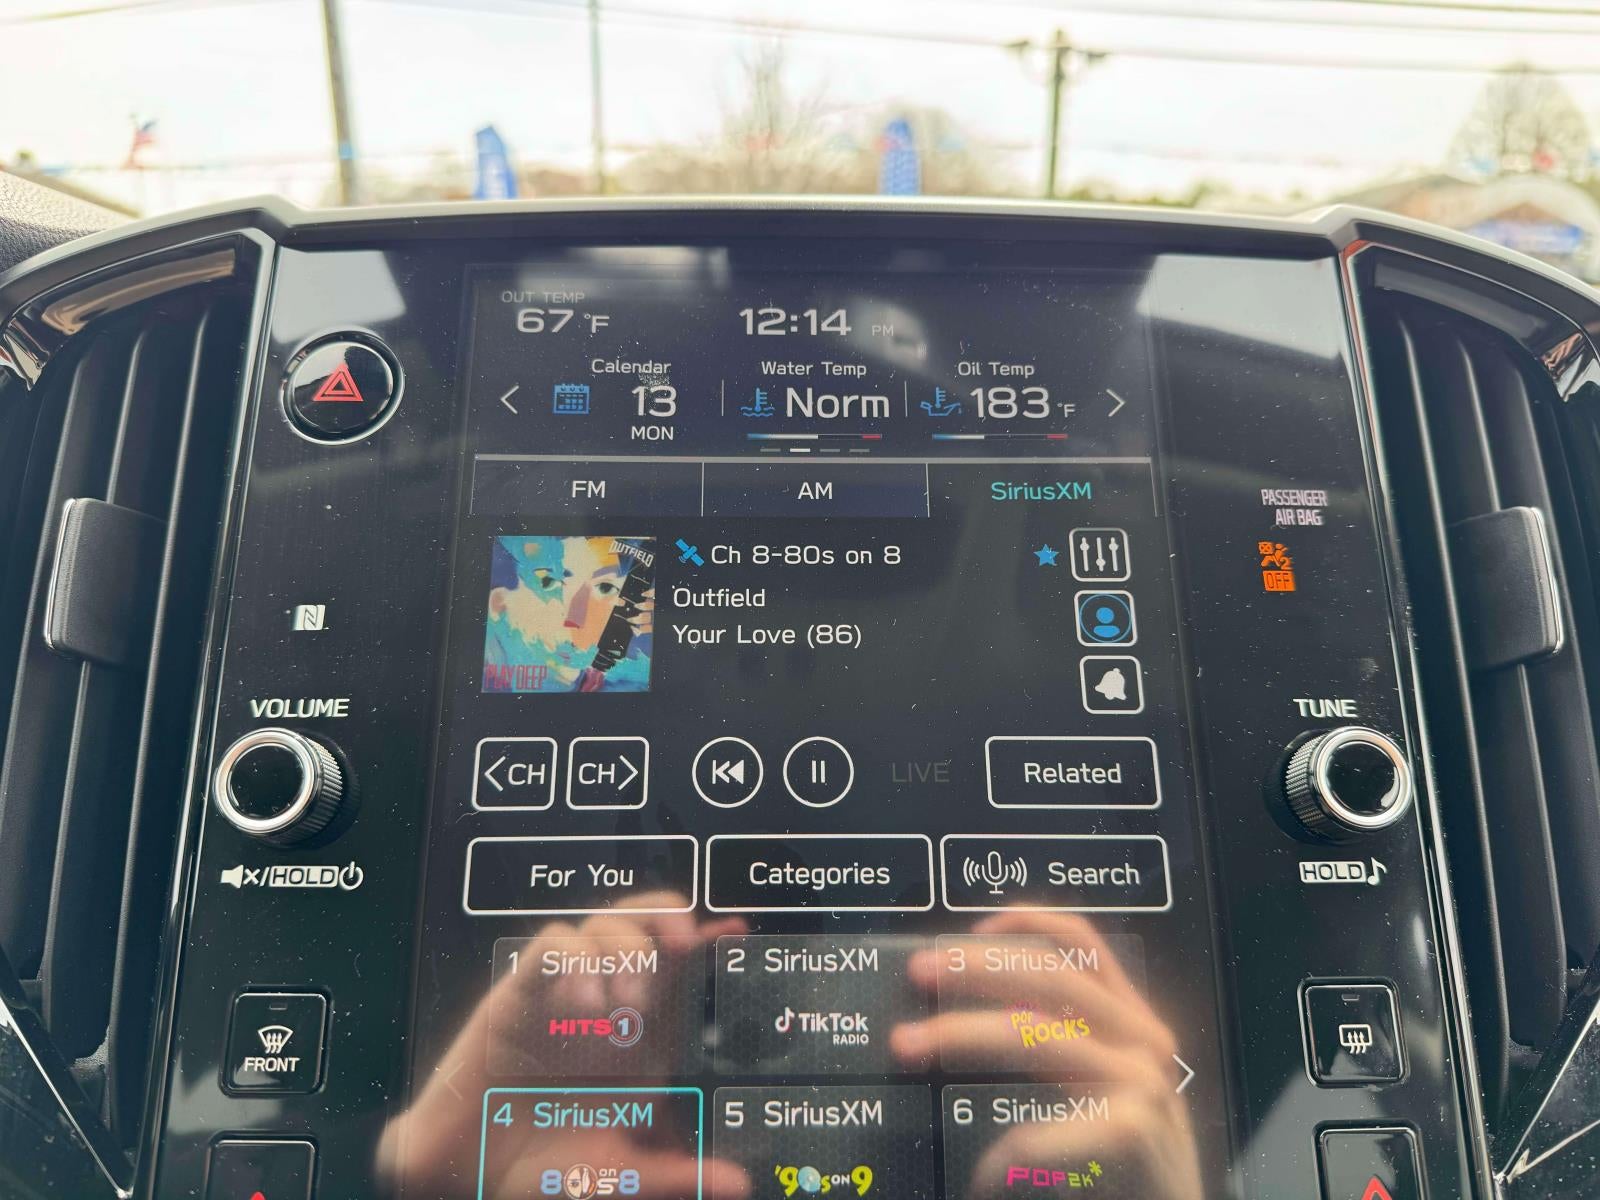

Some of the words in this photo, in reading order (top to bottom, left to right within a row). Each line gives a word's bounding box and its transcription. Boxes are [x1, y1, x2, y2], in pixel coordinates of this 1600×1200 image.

[501, 291, 533, 303] OUT
[543, 291, 585, 303] TEMP
[516, 309, 574, 333] 67
[739, 308, 852, 336] 12:14
[872, 325, 894, 337] PM
[591, 359, 671, 374] Calendar
[761, 361, 813, 376] Water
[822, 362, 867, 379] Temp
[958, 361, 981, 376] Oil
[989, 362, 1035, 379] Temp
[631, 385, 677, 417] 13
[786, 387, 890, 418] Norm
[970, 387, 1050, 419] 183
[631, 426, 674, 440] MON
[572, 480, 606, 498] FM
[798, 482, 833, 500] AM
[991, 482, 1092, 500] SiriusXM
[1261, 489, 1328, 506] PASSENGER
[1275, 509, 1295, 525] AIR
[1296, 509, 1323, 526] BAG
[609, 540, 654, 568] OUTFIELD
[711, 545, 740, 565] Ch
[752, 545, 835, 565] 8-80s
[845, 550, 872, 565] on
[884, 545, 901, 565] 8
[1265, 572, 1291, 590] OFF
[673, 588, 766, 608] Outfield
[672, 625, 729, 645] Your
[737, 625, 796, 645] Love
[807, 624, 862, 648] (86)
[485, 664, 514, 689] PLAY
[516, 665, 547, 690] DEEP
[250, 699, 350, 718] VOLUME
[1293, 698, 1358, 718] TUNE
[508, 763, 545, 785] CH
[578, 763, 615, 785] CH
[891, 762, 949, 783] LIVE
[1024, 762, 1122, 784] Related
[271, 867, 338, 886] HOLD
[530, 865, 576, 887] For
[588, 864, 634, 886] You
[749, 862, 891, 890] Categories
[1048, 862, 1141, 886] Search
[1301, 862, 1364, 881] HOLD
[508, 951, 519, 974] 1
[541, 950, 657, 975] SiriusXM
[727, 949, 745, 973] 2
[764, 948, 878, 973] SiriusXM
[947, 948, 966, 972] 3
[984, 948, 1099, 972] SiriusXM
[798, 1012, 869, 1032] TikTok
[1020, 1017, 1091, 1048] ROCKS
[833, 1034, 869, 1045] RADIO
[244, 1057, 300, 1072] FRONT
[493, 1103, 513, 1127] 4
[533, 1102, 653, 1128] SiriusXM
[725, 1101, 744, 1127] 5
[764, 1100, 883, 1127] SiriusXM
[953, 1099, 974, 1125] 6
[992, 1097, 1109, 1124] SiriusXM
[851, 1166, 873, 1196] 9
